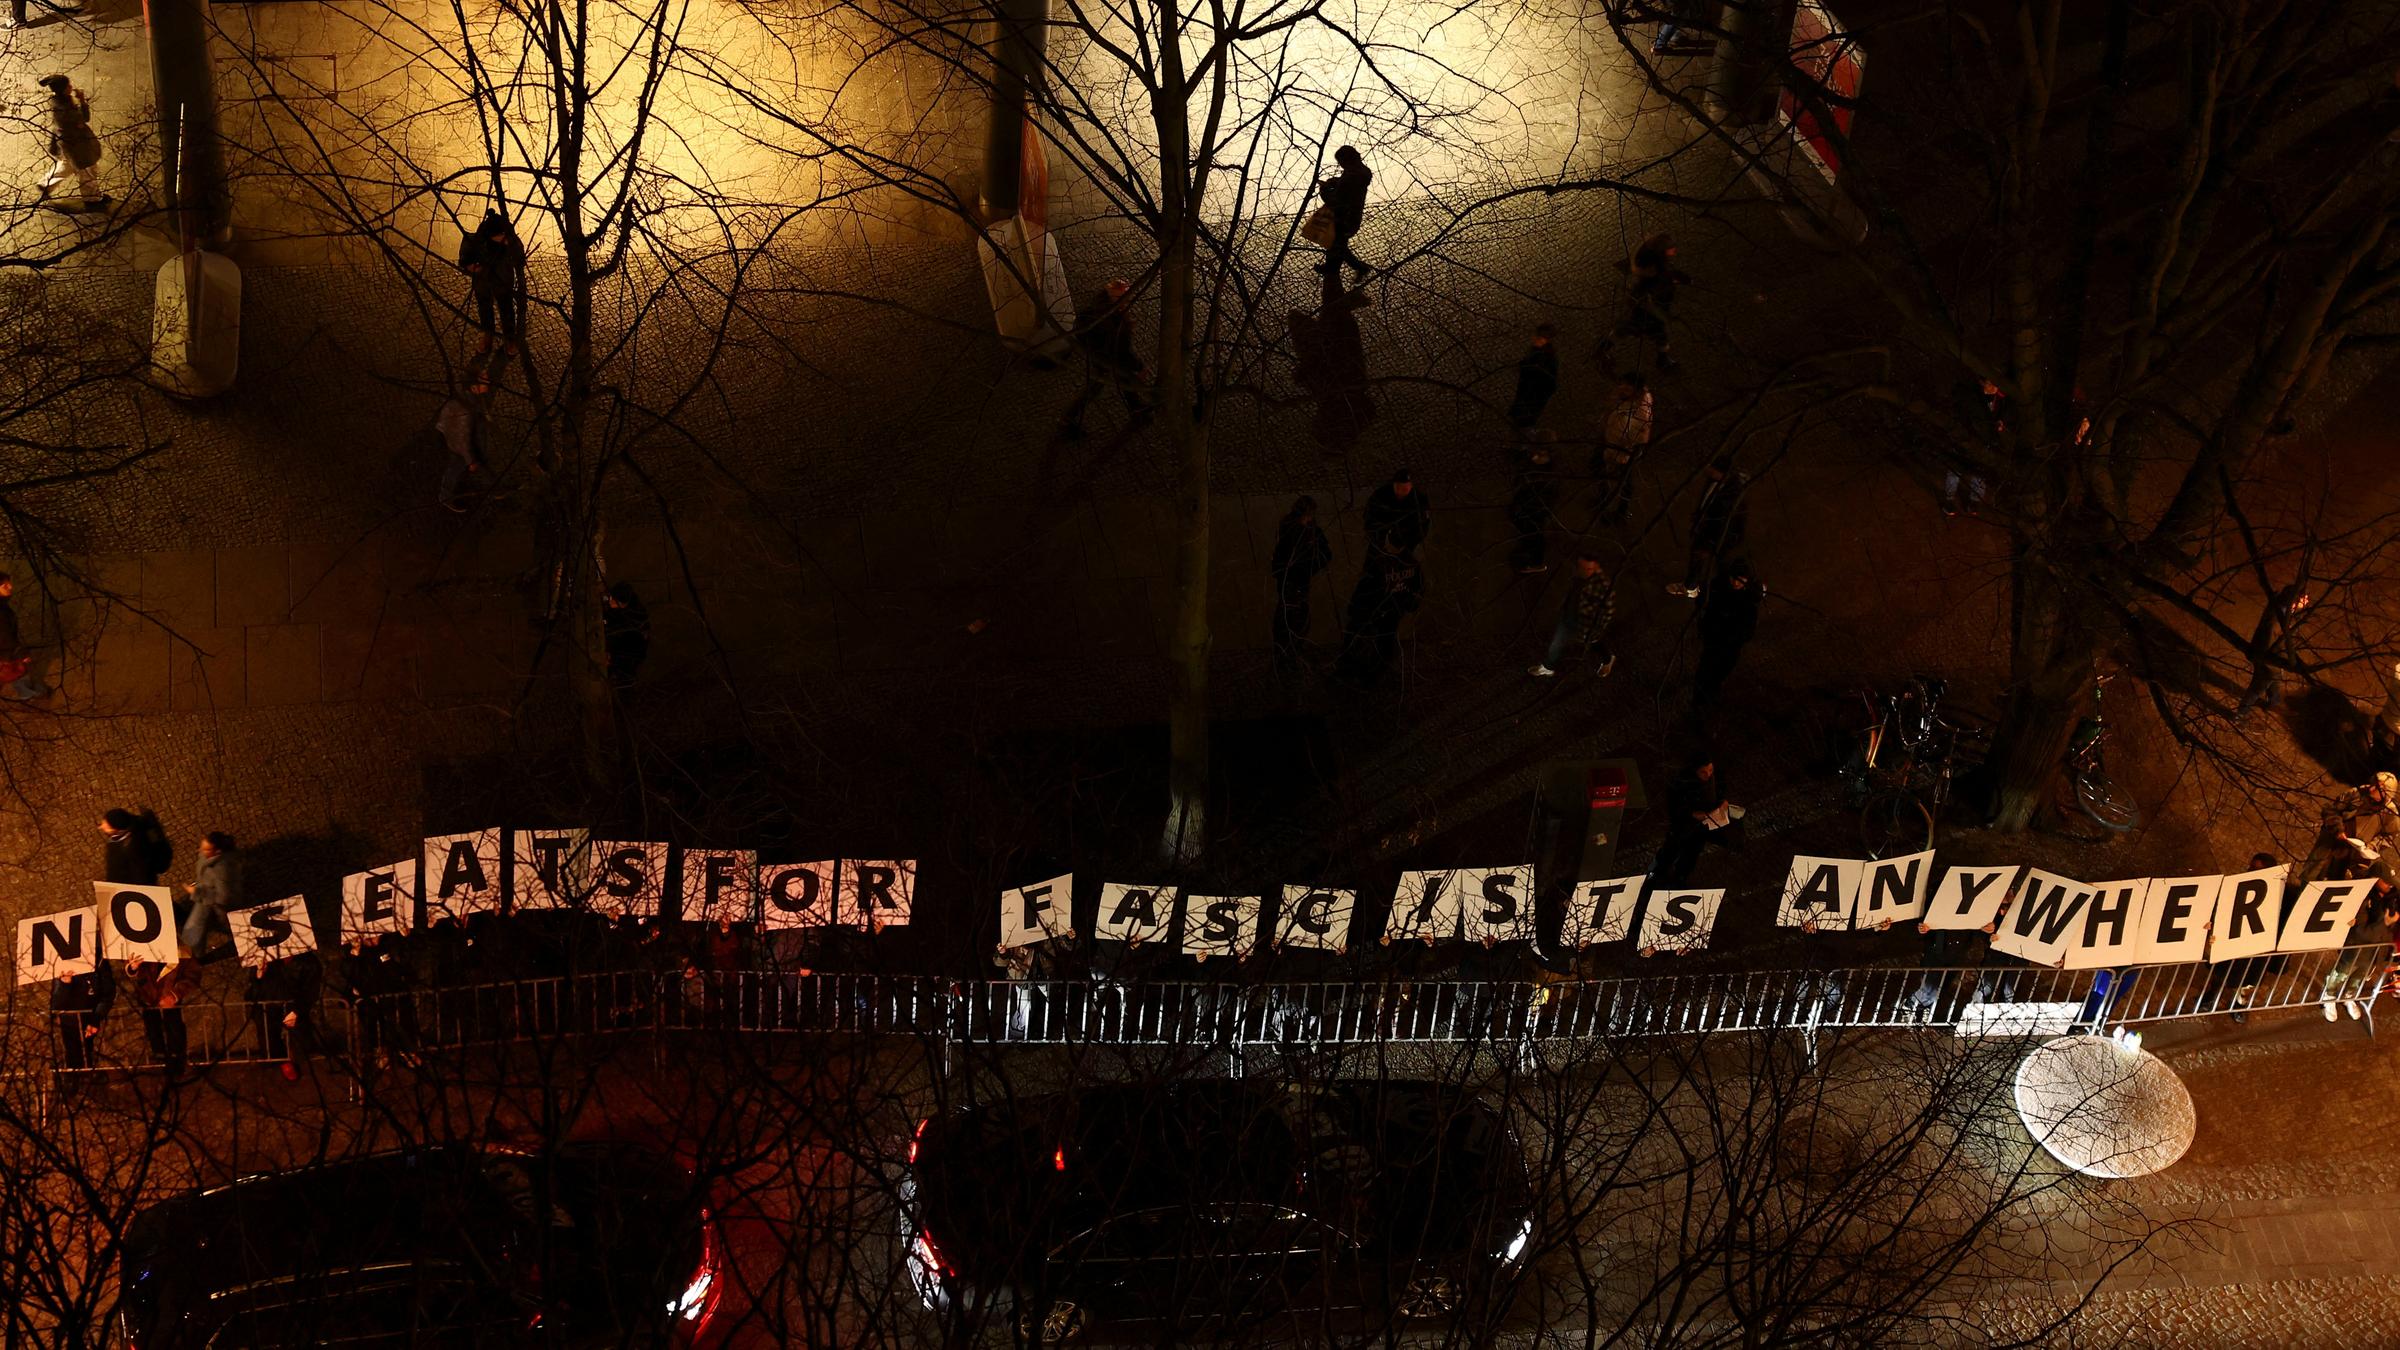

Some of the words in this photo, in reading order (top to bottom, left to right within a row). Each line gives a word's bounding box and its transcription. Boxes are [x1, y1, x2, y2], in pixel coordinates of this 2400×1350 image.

[31, 890, 162, 966] NO
[249, 837, 646, 947] SEATS
[705, 857, 897, 912] FOR
[1023, 874, 1702, 940] FASCISTS
[1792, 858, 2354, 947] ANYWHERE
